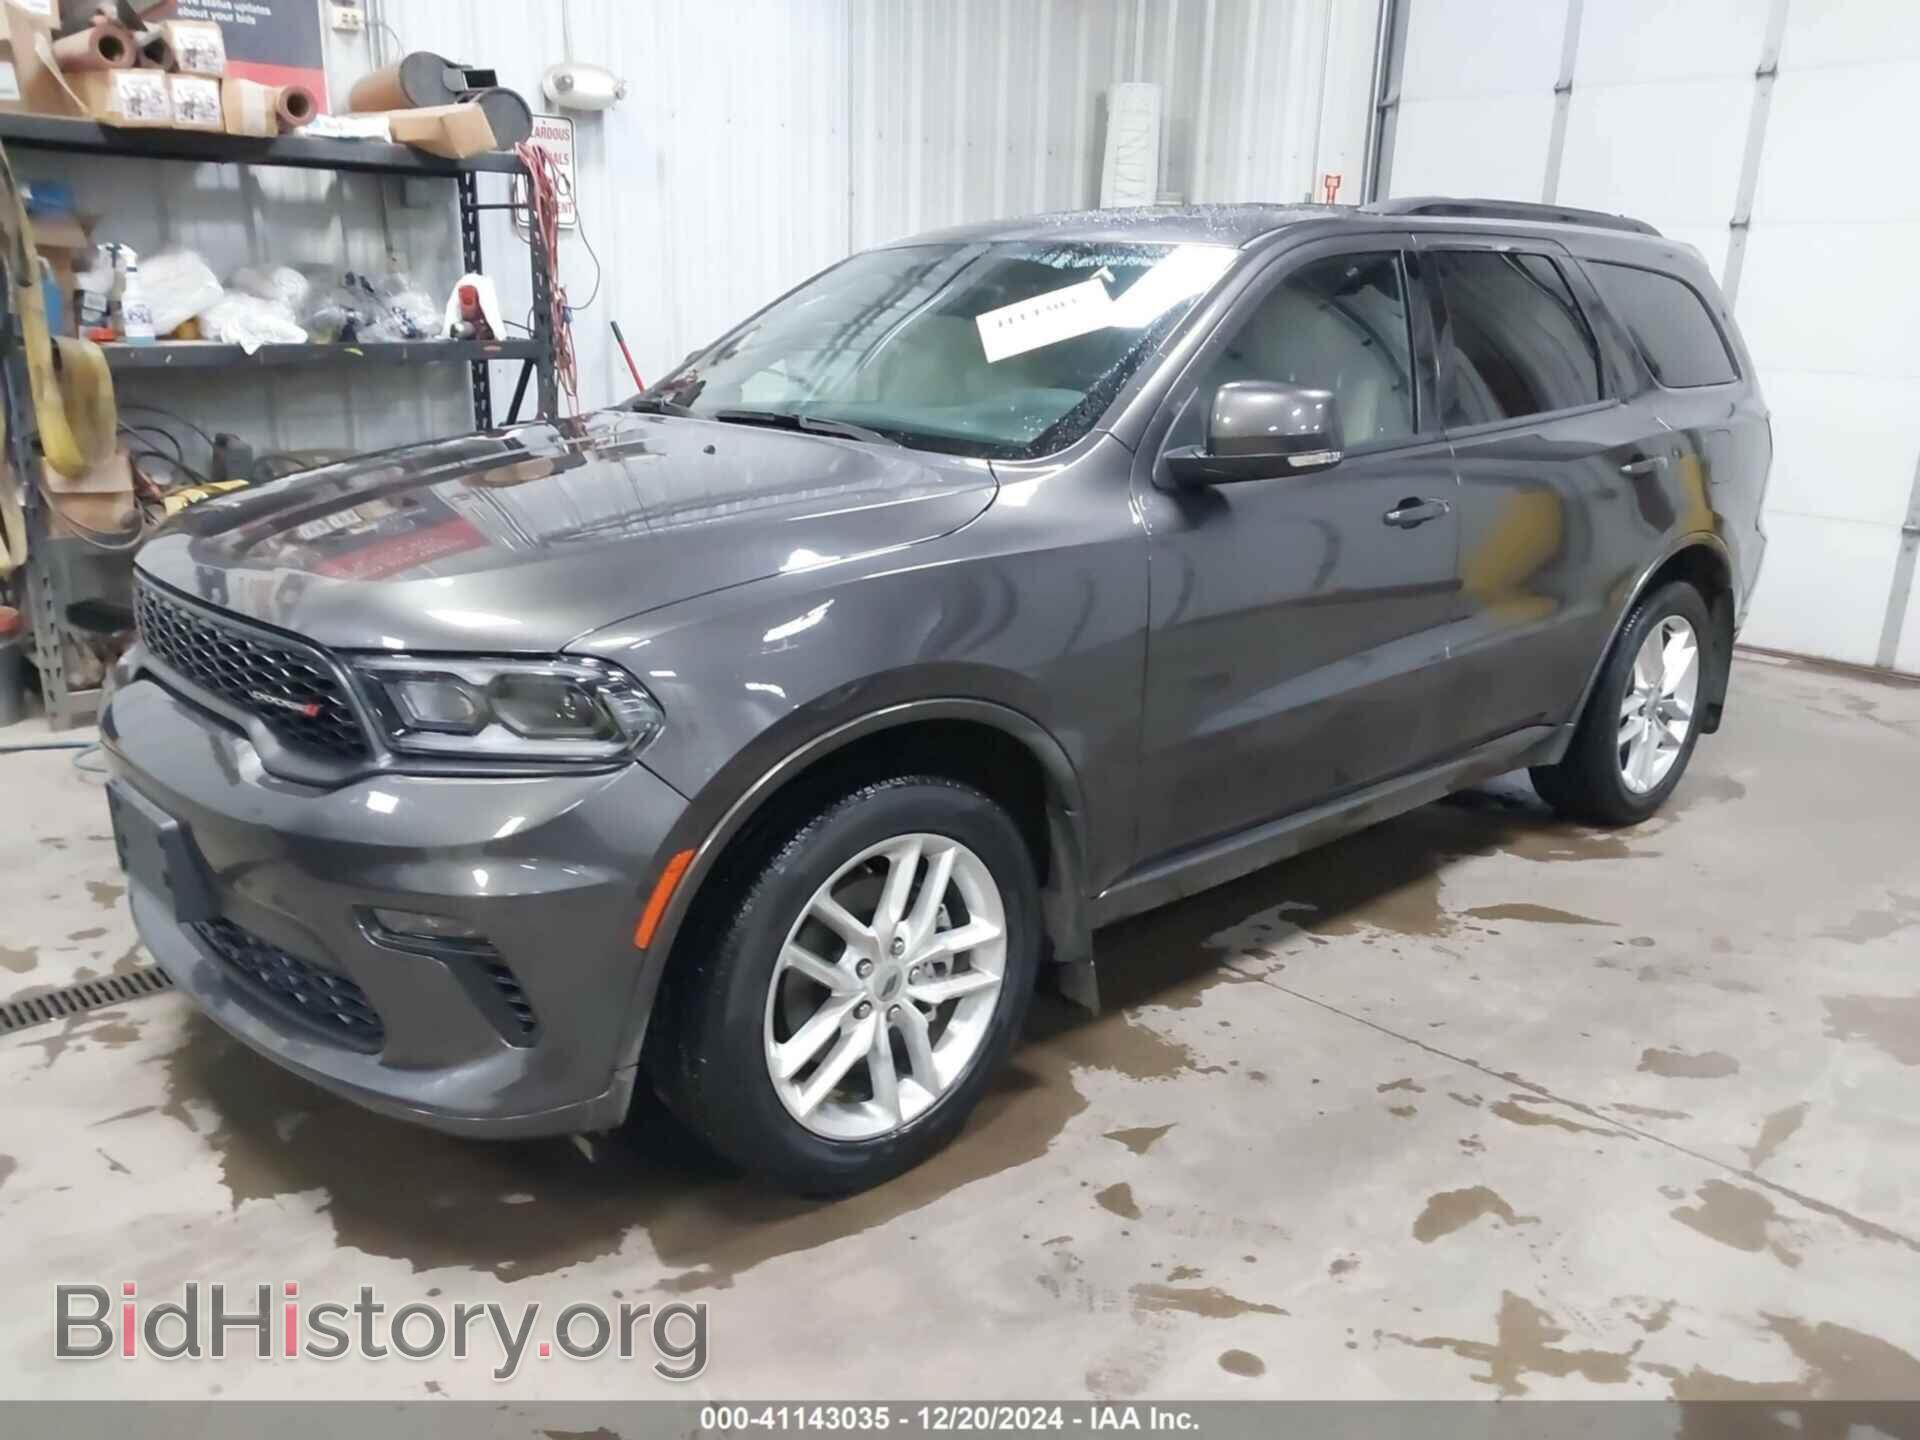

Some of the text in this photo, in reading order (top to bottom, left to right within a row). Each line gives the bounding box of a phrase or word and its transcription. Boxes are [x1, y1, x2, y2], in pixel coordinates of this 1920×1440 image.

[176, 6, 256, 25] about your bids
